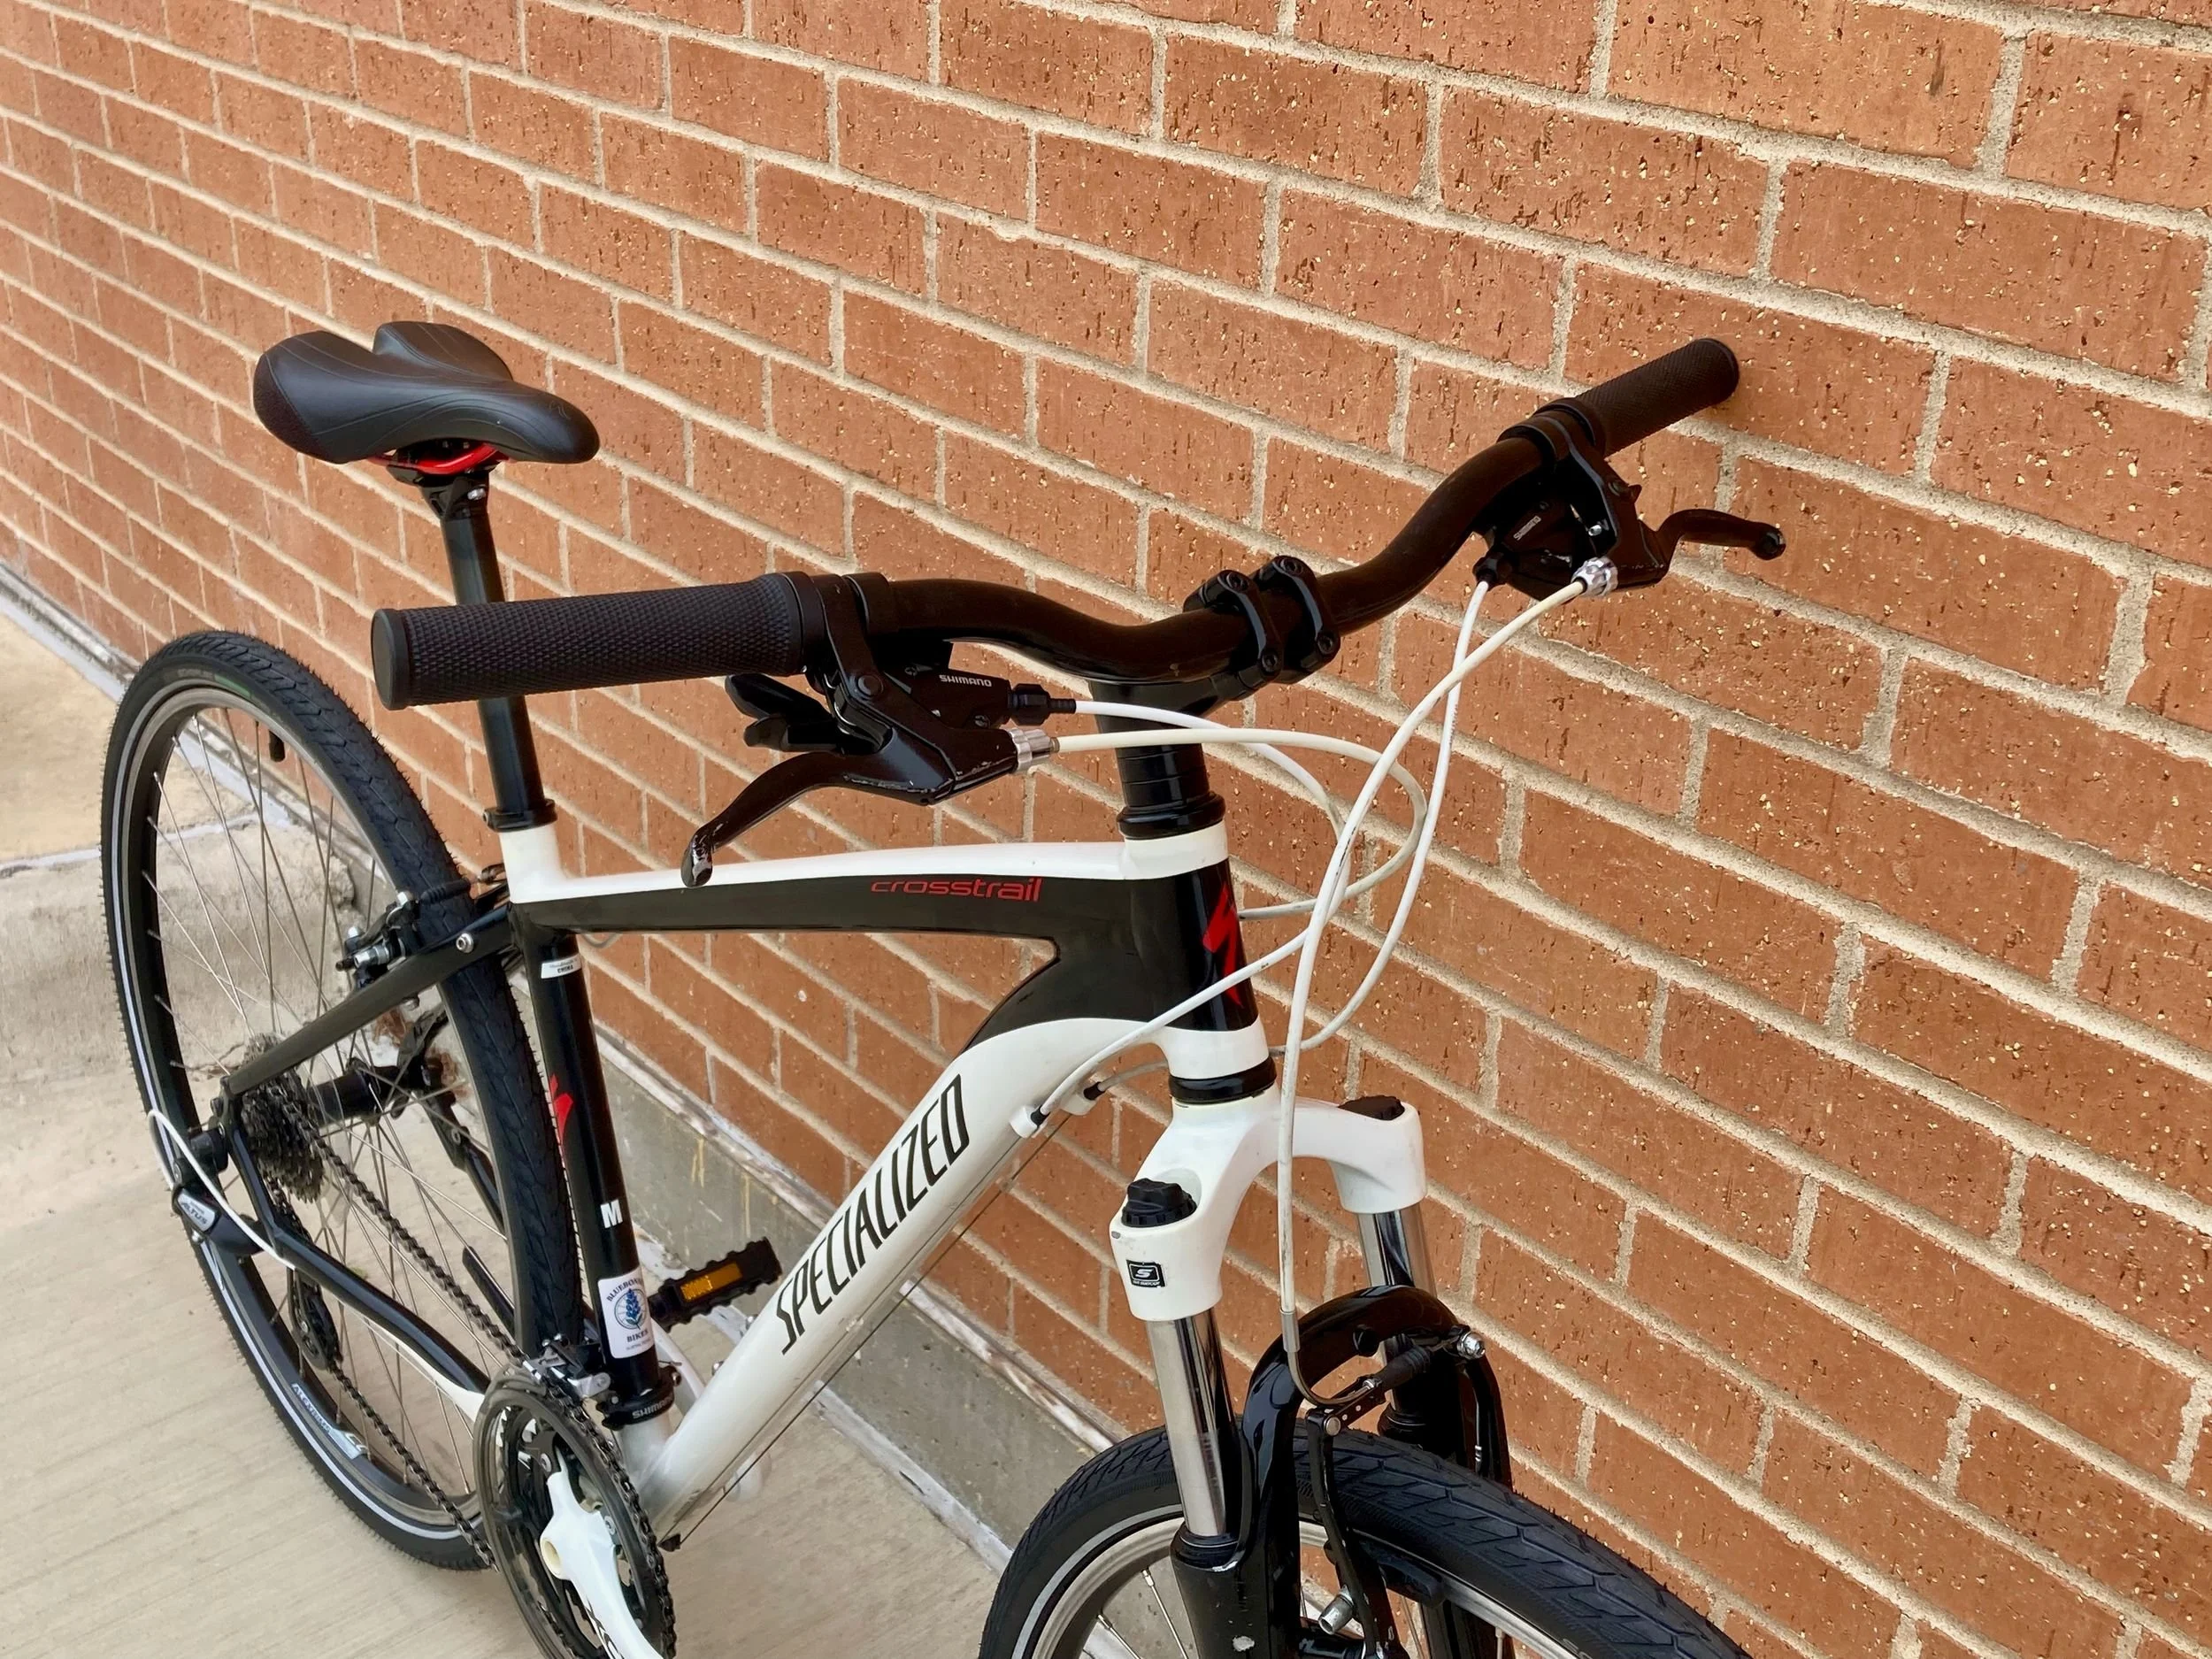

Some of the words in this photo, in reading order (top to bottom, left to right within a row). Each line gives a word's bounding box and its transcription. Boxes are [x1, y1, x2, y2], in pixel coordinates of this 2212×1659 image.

[939, 674, 993, 687] SHIMANO
[871, 878, 1043, 902] crosstrail
[776, 1073, 970, 1356] SPECIALIZED
[632, 1394, 674, 1419] SHIMAN
